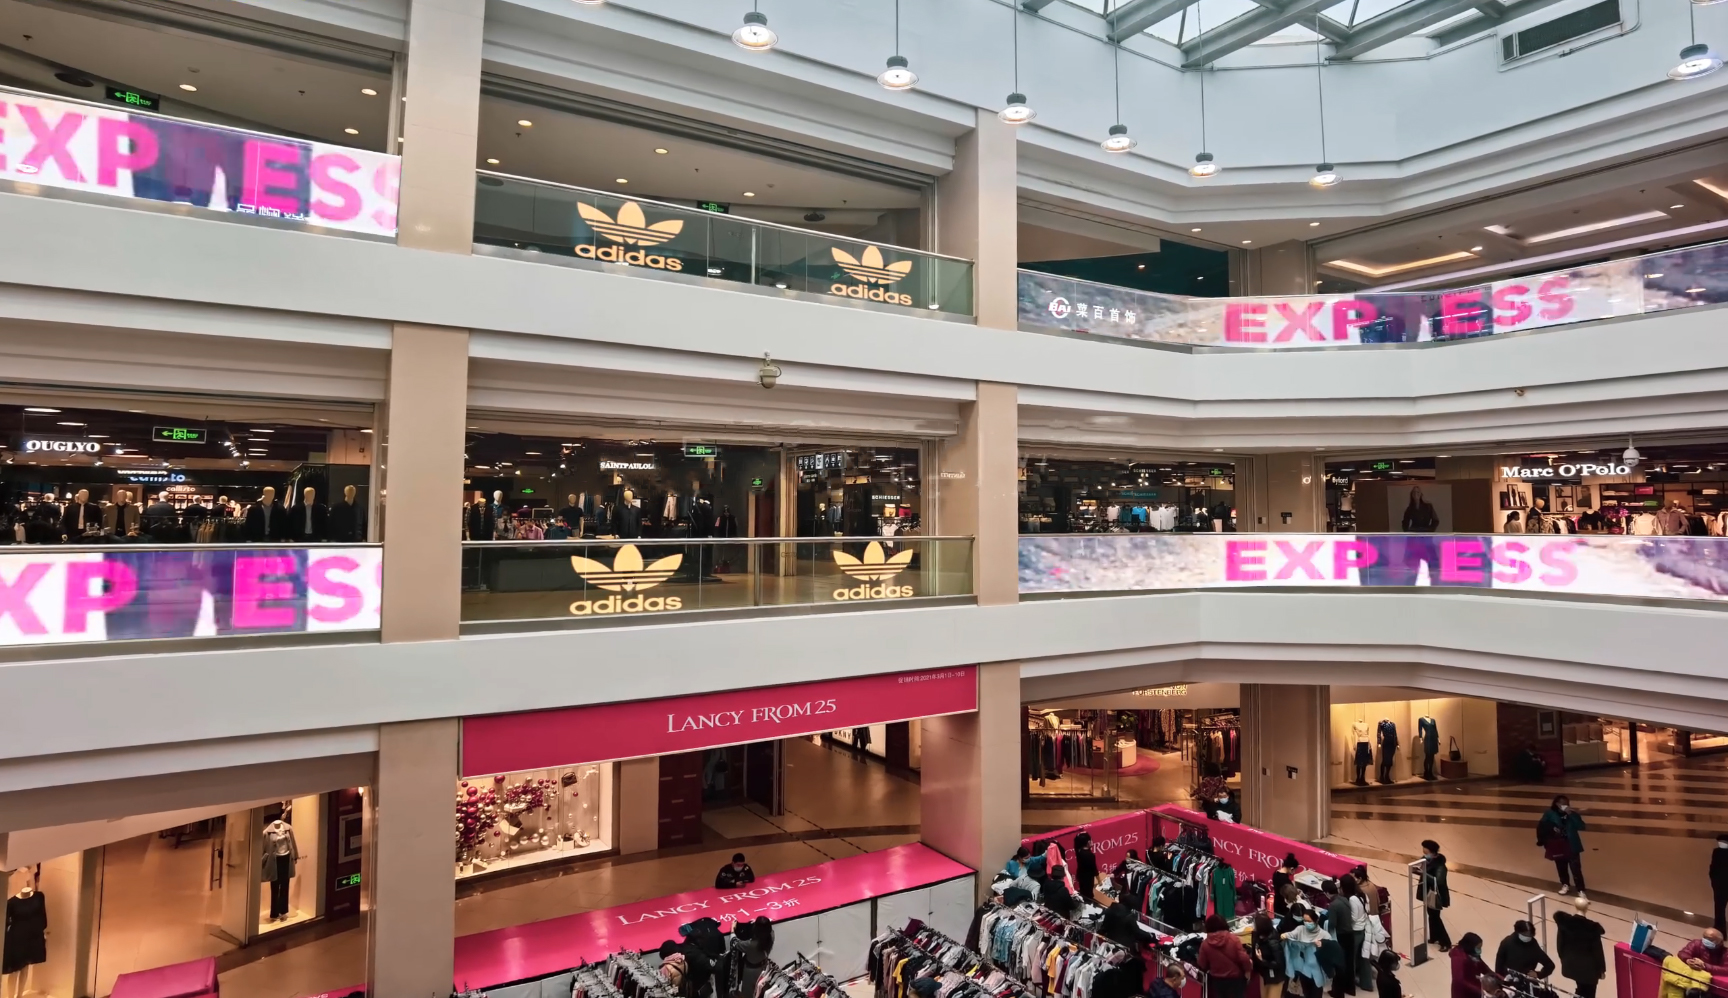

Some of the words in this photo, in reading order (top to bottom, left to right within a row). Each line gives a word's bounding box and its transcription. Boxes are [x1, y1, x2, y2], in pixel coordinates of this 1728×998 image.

[574, 242, 684, 272] adidas
[830, 282, 913, 306] adidas
[1076, 302, 1136, 324] 菜百首饰
[26, 440, 100, 452] OUGLYO
[1501, 465, 1553, 478] Marc
[1559, 463, 1630, 476] O'Polo
[833, 582, 914, 602] adidas
[569, 593, 683, 615] adidas
[751, 702, 811, 724] FROM
[815, 699, 837, 715] 25
[1125, 832, 1138, 846] 25
[617, 900, 710, 926] LANCY
[719, 882, 793, 904] FROM
[797, 876, 822, 888] 25
